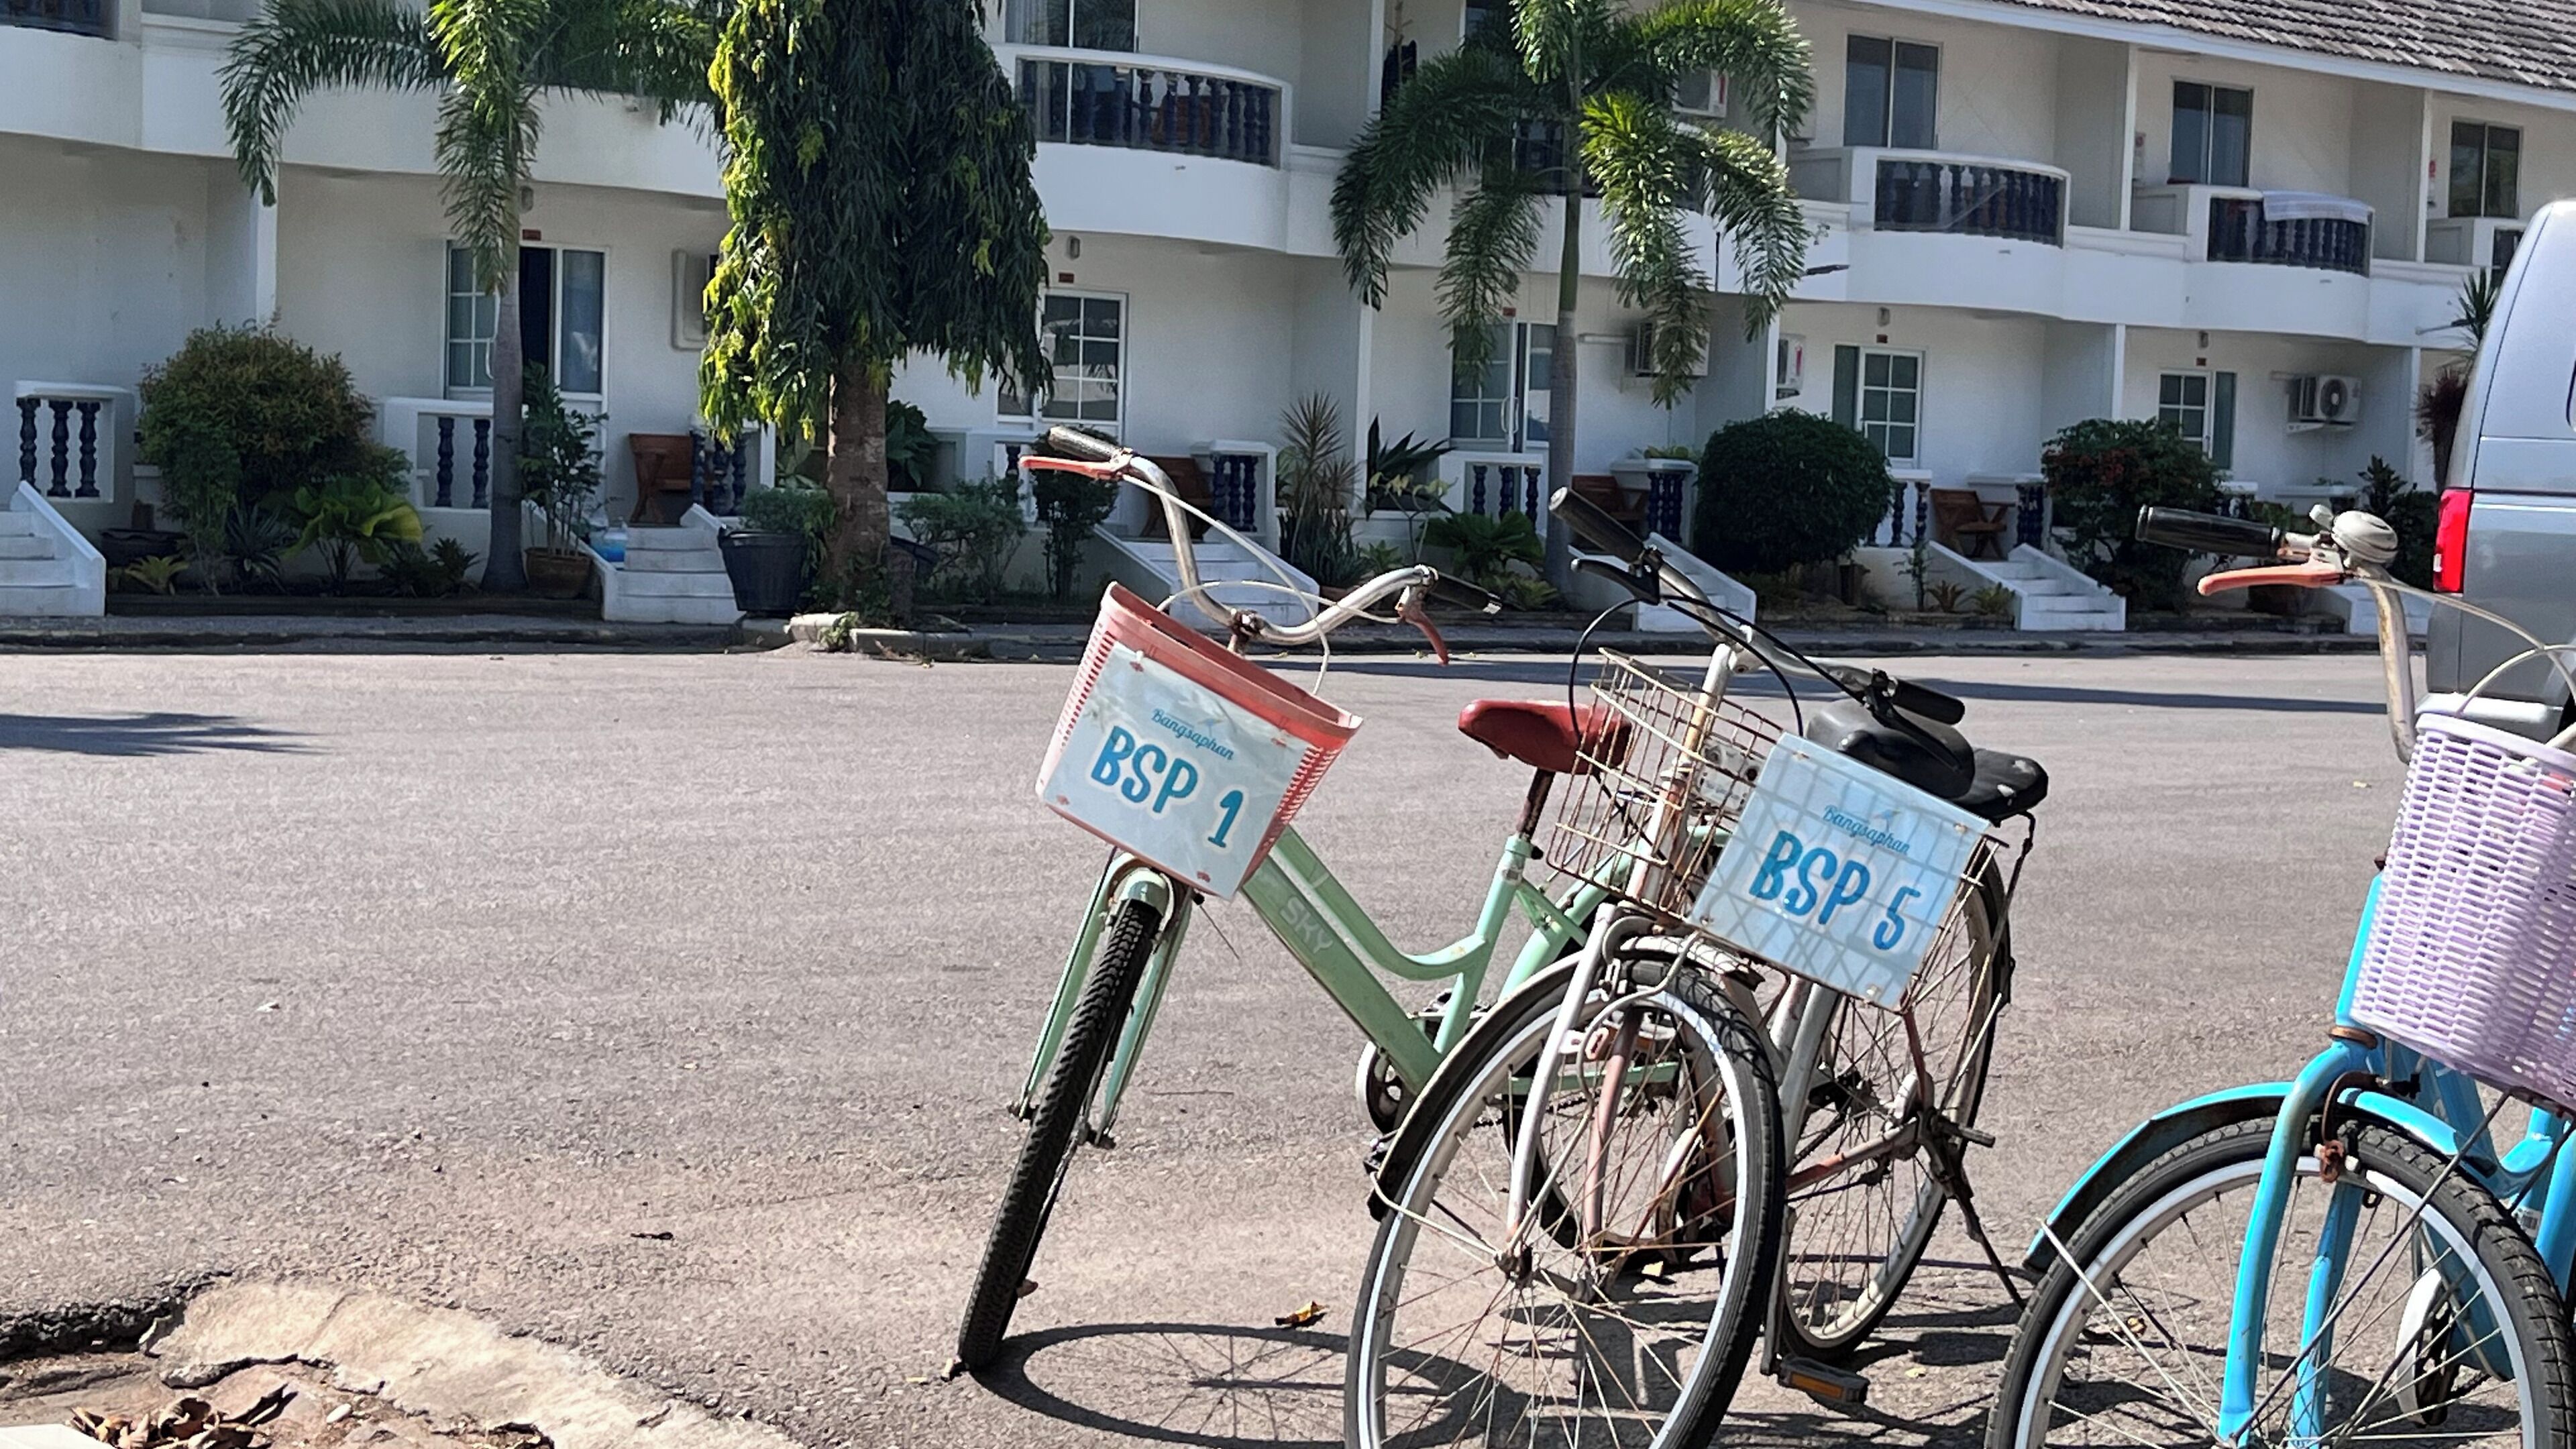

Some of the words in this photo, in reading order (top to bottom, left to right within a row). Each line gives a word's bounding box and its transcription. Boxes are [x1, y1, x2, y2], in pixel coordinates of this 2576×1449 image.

[1151, 708, 1234, 761] Bangsaphan
[1091, 726, 1198, 814] BSP
[1208, 790, 1243, 847] 1
[1823, 805, 1911, 855] Bangsaphan
[1749, 830, 1870, 924] BSP
[1874, 886, 1921, 950] 5
[1279, 896, 1334, 954] SKY
